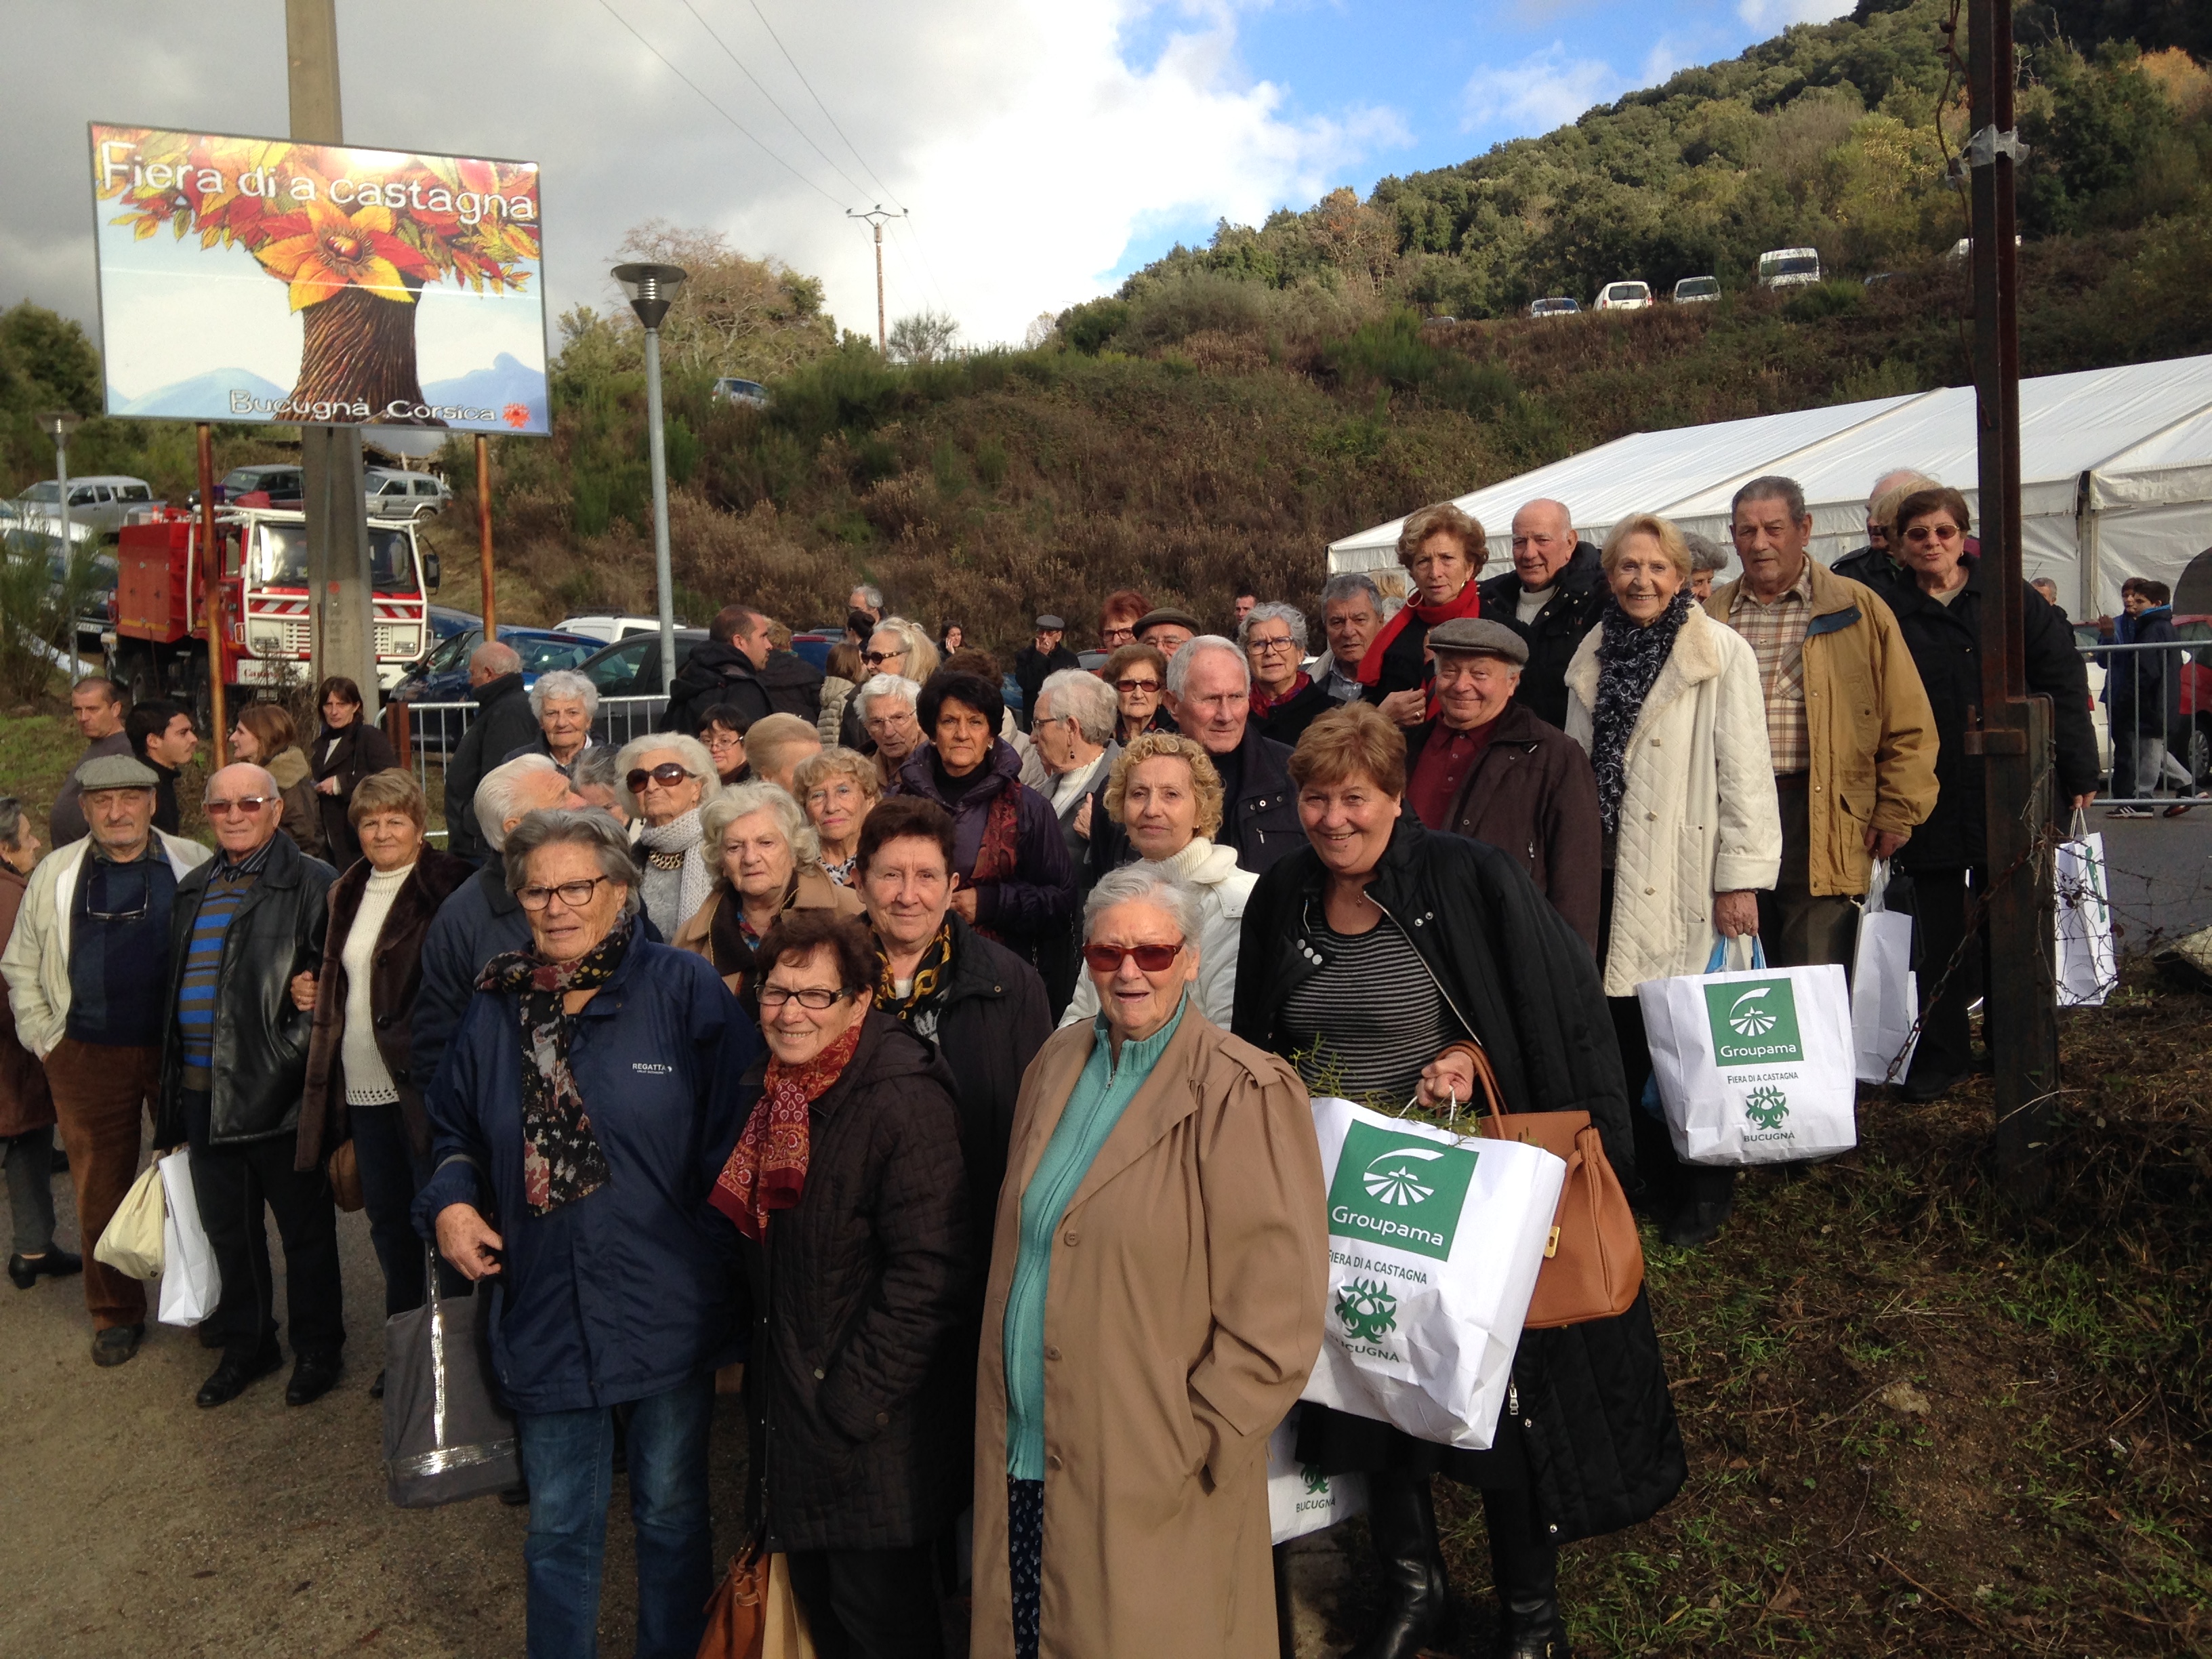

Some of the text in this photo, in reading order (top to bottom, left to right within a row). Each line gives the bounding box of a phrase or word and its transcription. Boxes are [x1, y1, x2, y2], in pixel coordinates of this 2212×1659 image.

[102, 140, 535, 225] Fiera di a castagna
[386, 399, 497, 422] Corsica
[1720, 1044, 1797, 1057] Groupama
[632, 1063, 666, 1071] REGATTA
[1727, 1075, 1748, 1084] FIERA
[1763, 1072, 1799, 1081] CASTAGNA
[1332, 1206, 1443, 1246] Groupama
[1353, 1256, 1364, 1269] DI
[1364, 1259, 1371, 1271] A
[1374, 1261, 1427, 1285] CASTAGNA
